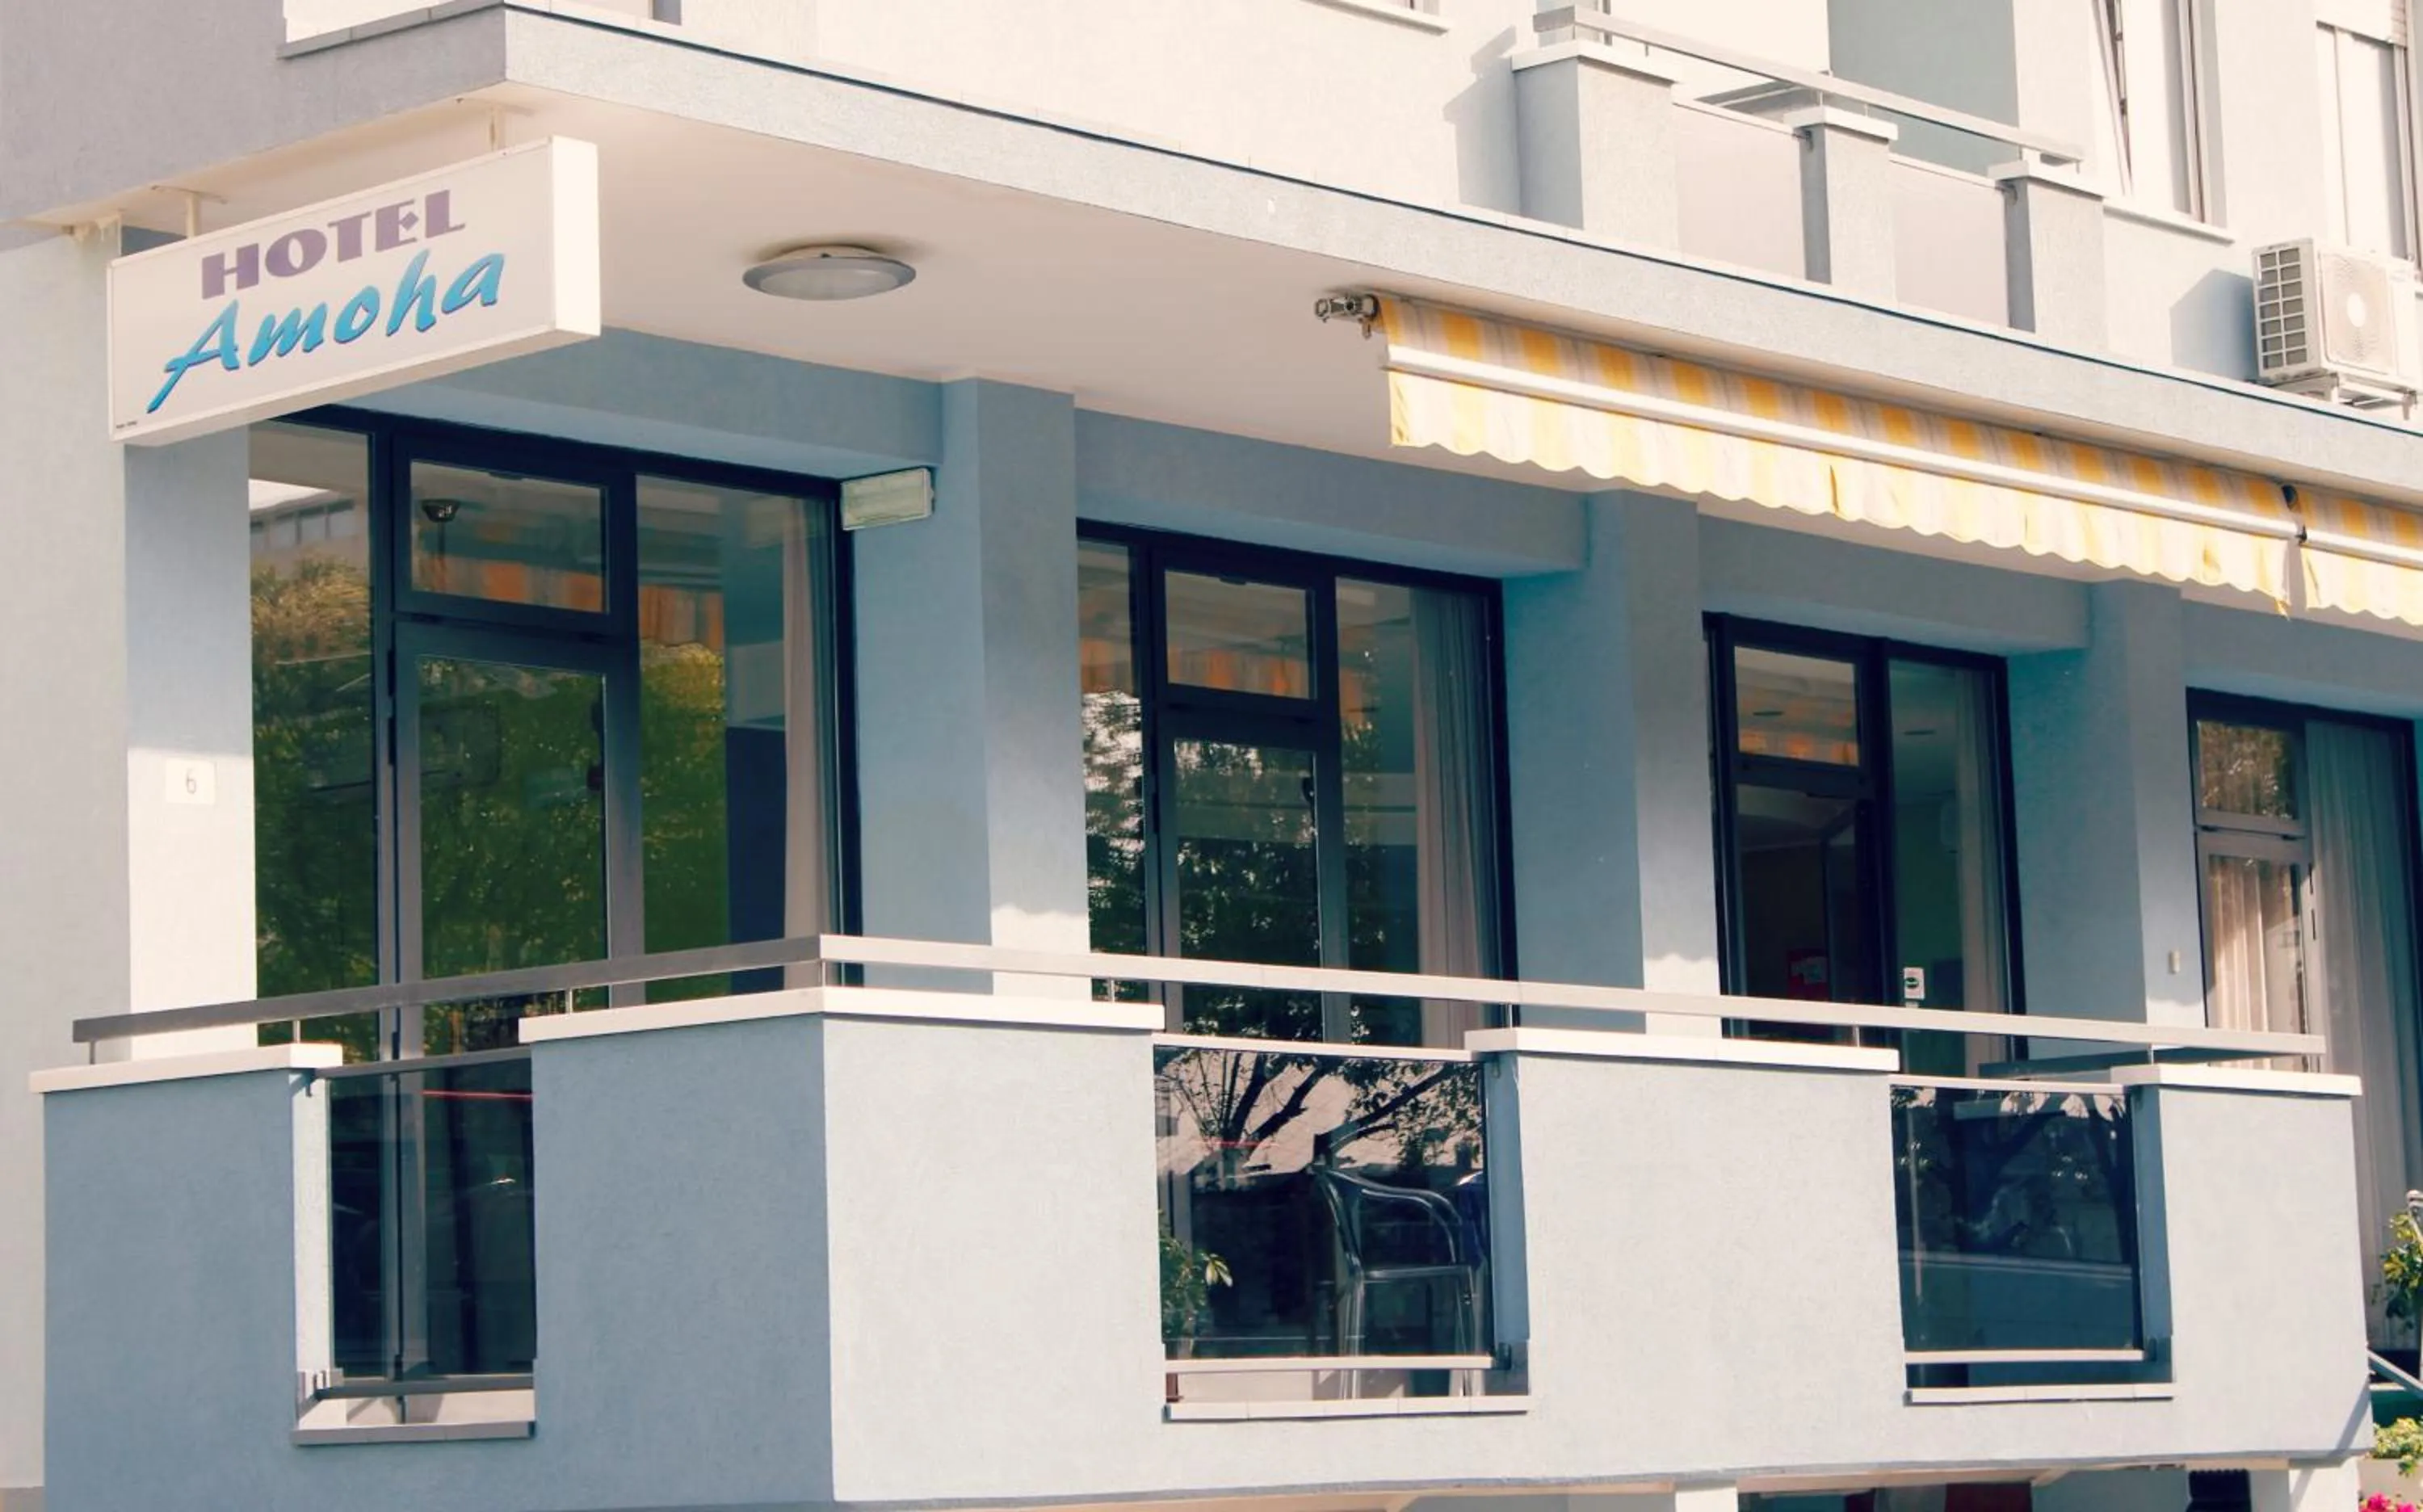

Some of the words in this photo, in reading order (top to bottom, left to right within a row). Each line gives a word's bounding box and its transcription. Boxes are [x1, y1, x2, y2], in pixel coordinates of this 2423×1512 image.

[202, 189, 466, 300] HOTEL
[146, 249, 506, 414] Amoha
[185, 767, 197, 795] 6
